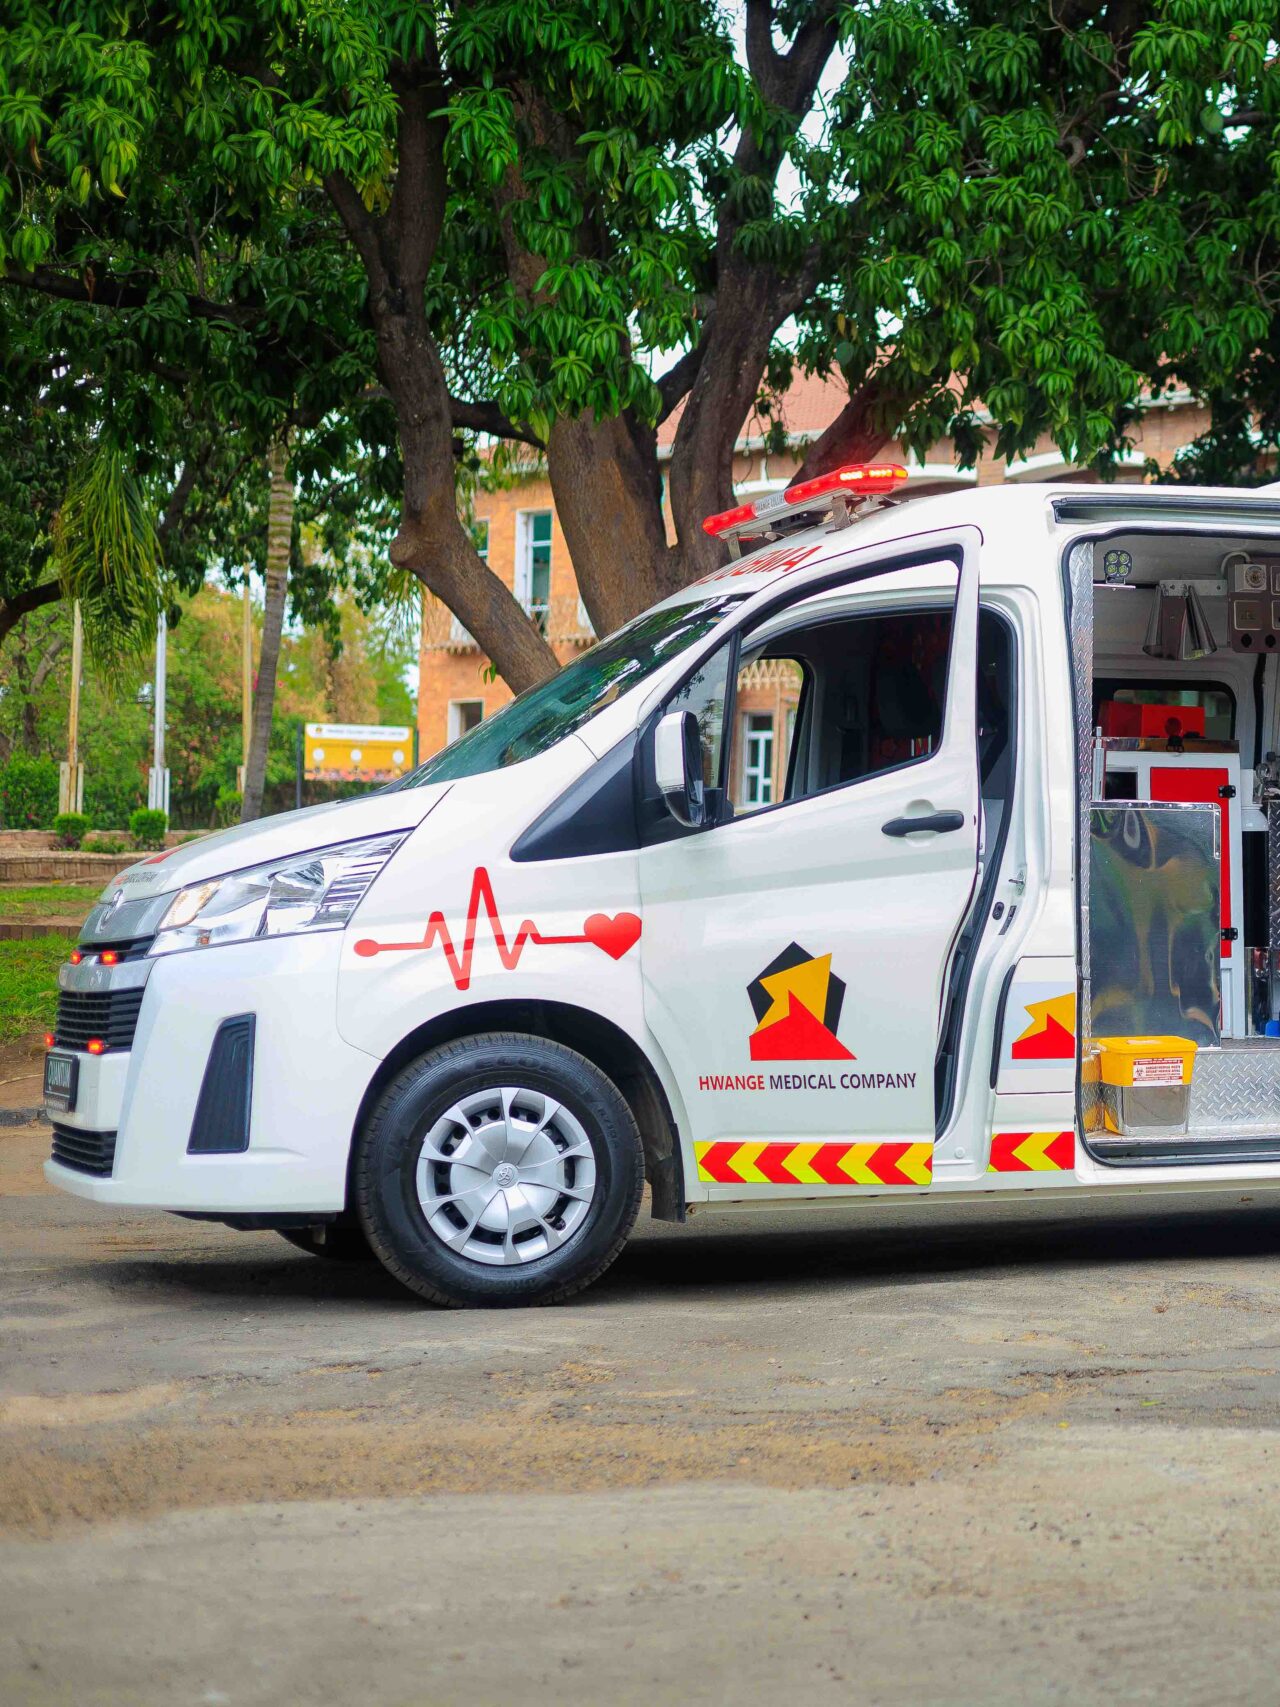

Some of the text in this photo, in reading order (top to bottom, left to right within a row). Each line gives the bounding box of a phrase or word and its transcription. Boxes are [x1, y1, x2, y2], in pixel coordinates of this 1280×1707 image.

[699, 1073, 916, 1090] HWANGE MEDICAL COMPANY
